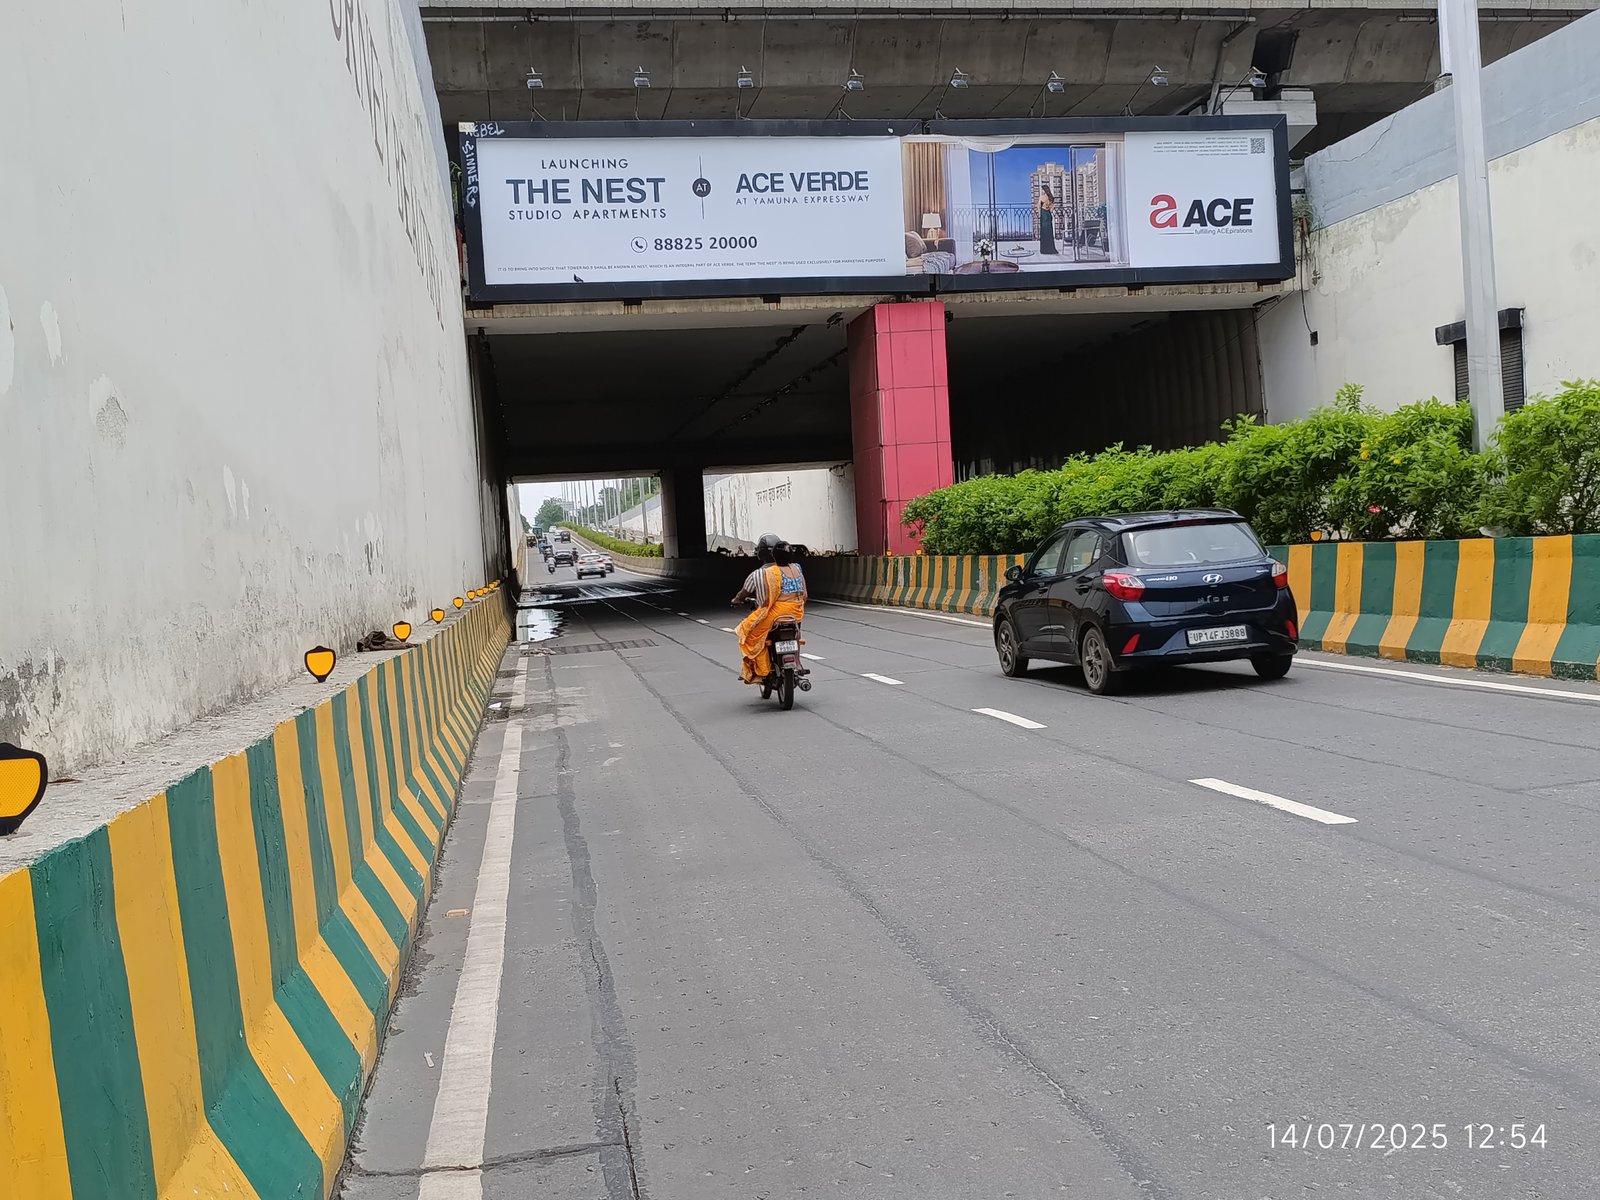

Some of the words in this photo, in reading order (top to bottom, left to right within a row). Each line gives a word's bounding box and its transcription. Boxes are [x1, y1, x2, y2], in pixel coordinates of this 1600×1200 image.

[541, 158, 629, 170] LAUNCHING
[461, 140, 479, 208] SINNER
[694, 181, 708, 193] AT
[735, 172, 785, 194] ACE
[789, 170, 869, 194] VERDE
[506, 178, 572, 205] THE
[581, 177, 666, 204] NEST
[735, 197, 747, 206] AT
[752, 196, 799, 205] YAMUNA
[803, 194, 870, 204] EXPRESSWAY
[508, 209, 562, 221] STUDIO
[572, 208, 667, 220] APARTMENTS
[1183, 197, 1254, 228] ACE
[1194, 228, 1216, 236] fulfilling
[1216, 227, 1253, 235] ACEpirations
[654, 237, 704, 251] 88825
[709, 235, 758, 250] 20000
